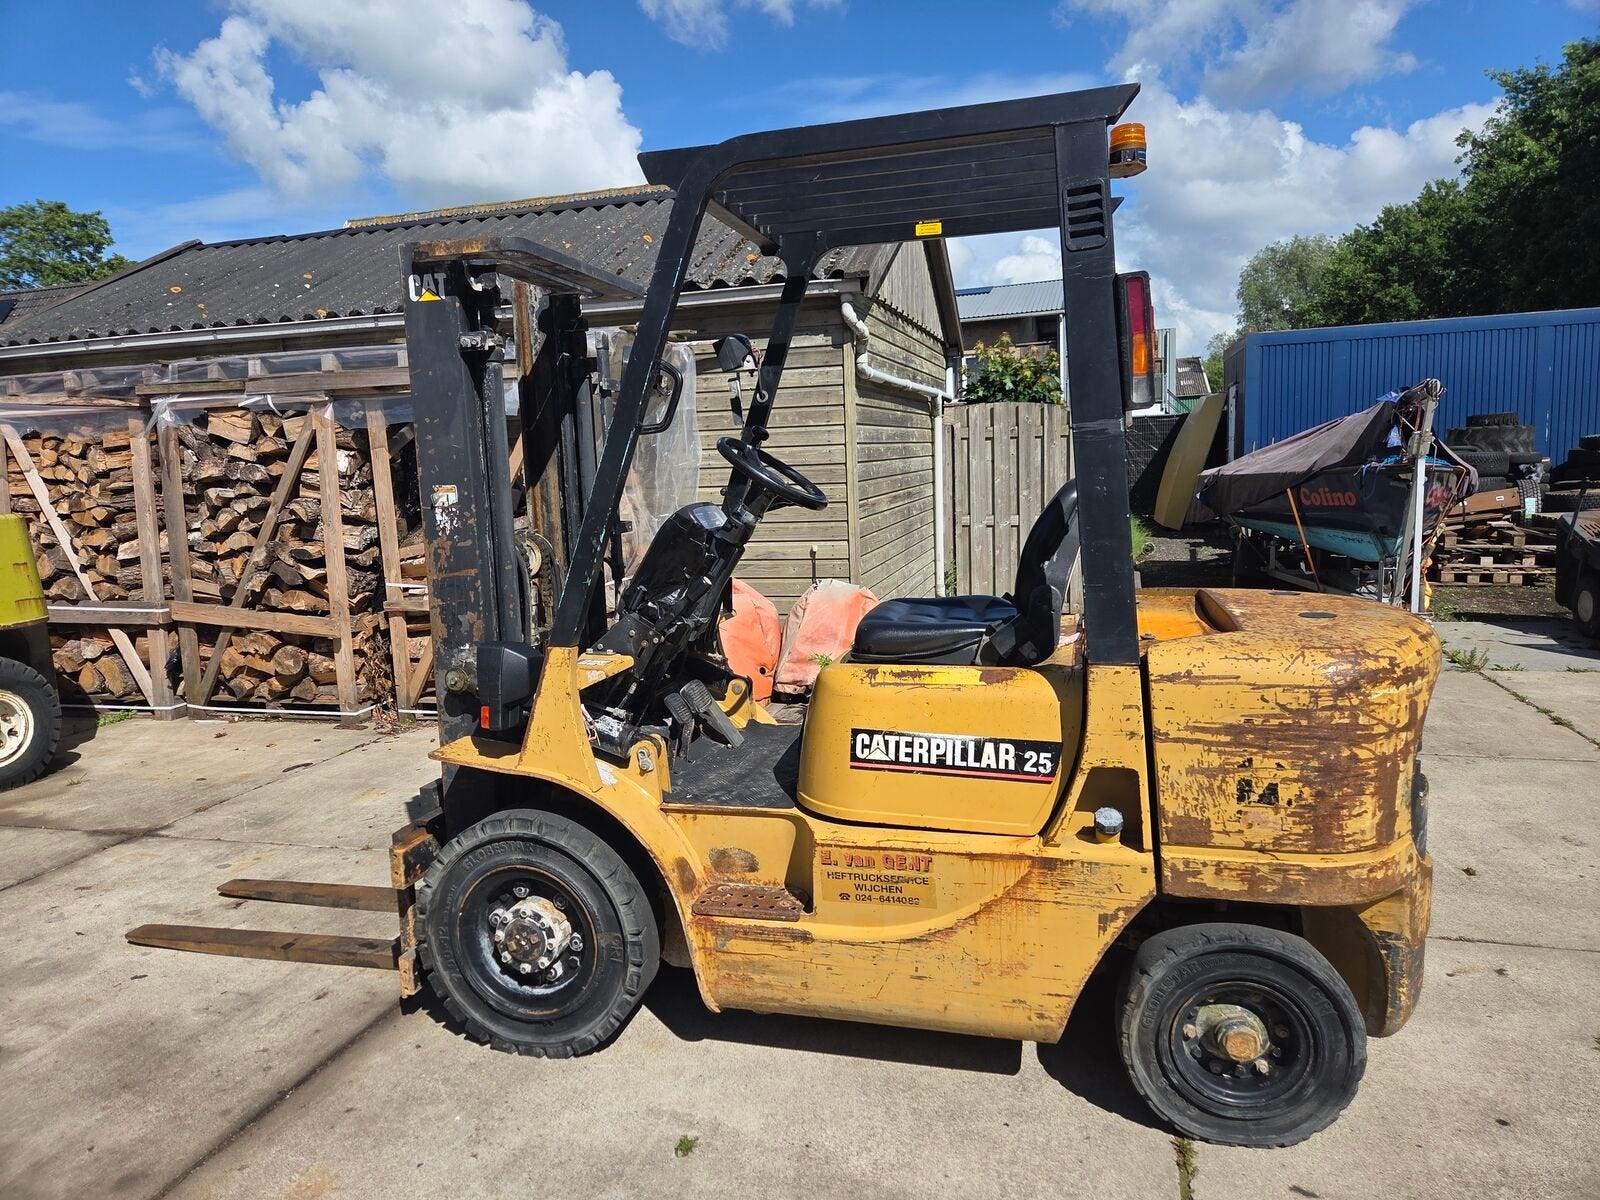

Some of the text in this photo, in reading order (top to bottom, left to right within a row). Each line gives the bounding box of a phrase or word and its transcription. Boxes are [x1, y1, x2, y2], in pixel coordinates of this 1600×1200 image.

[408, 272, 447, 302] CAT
[1301, 488, 1357, 507] Colino
[855, 733, 1053, 774] CATERPILLAR 25
[854, 883, 903, 894] WIJCHEN
